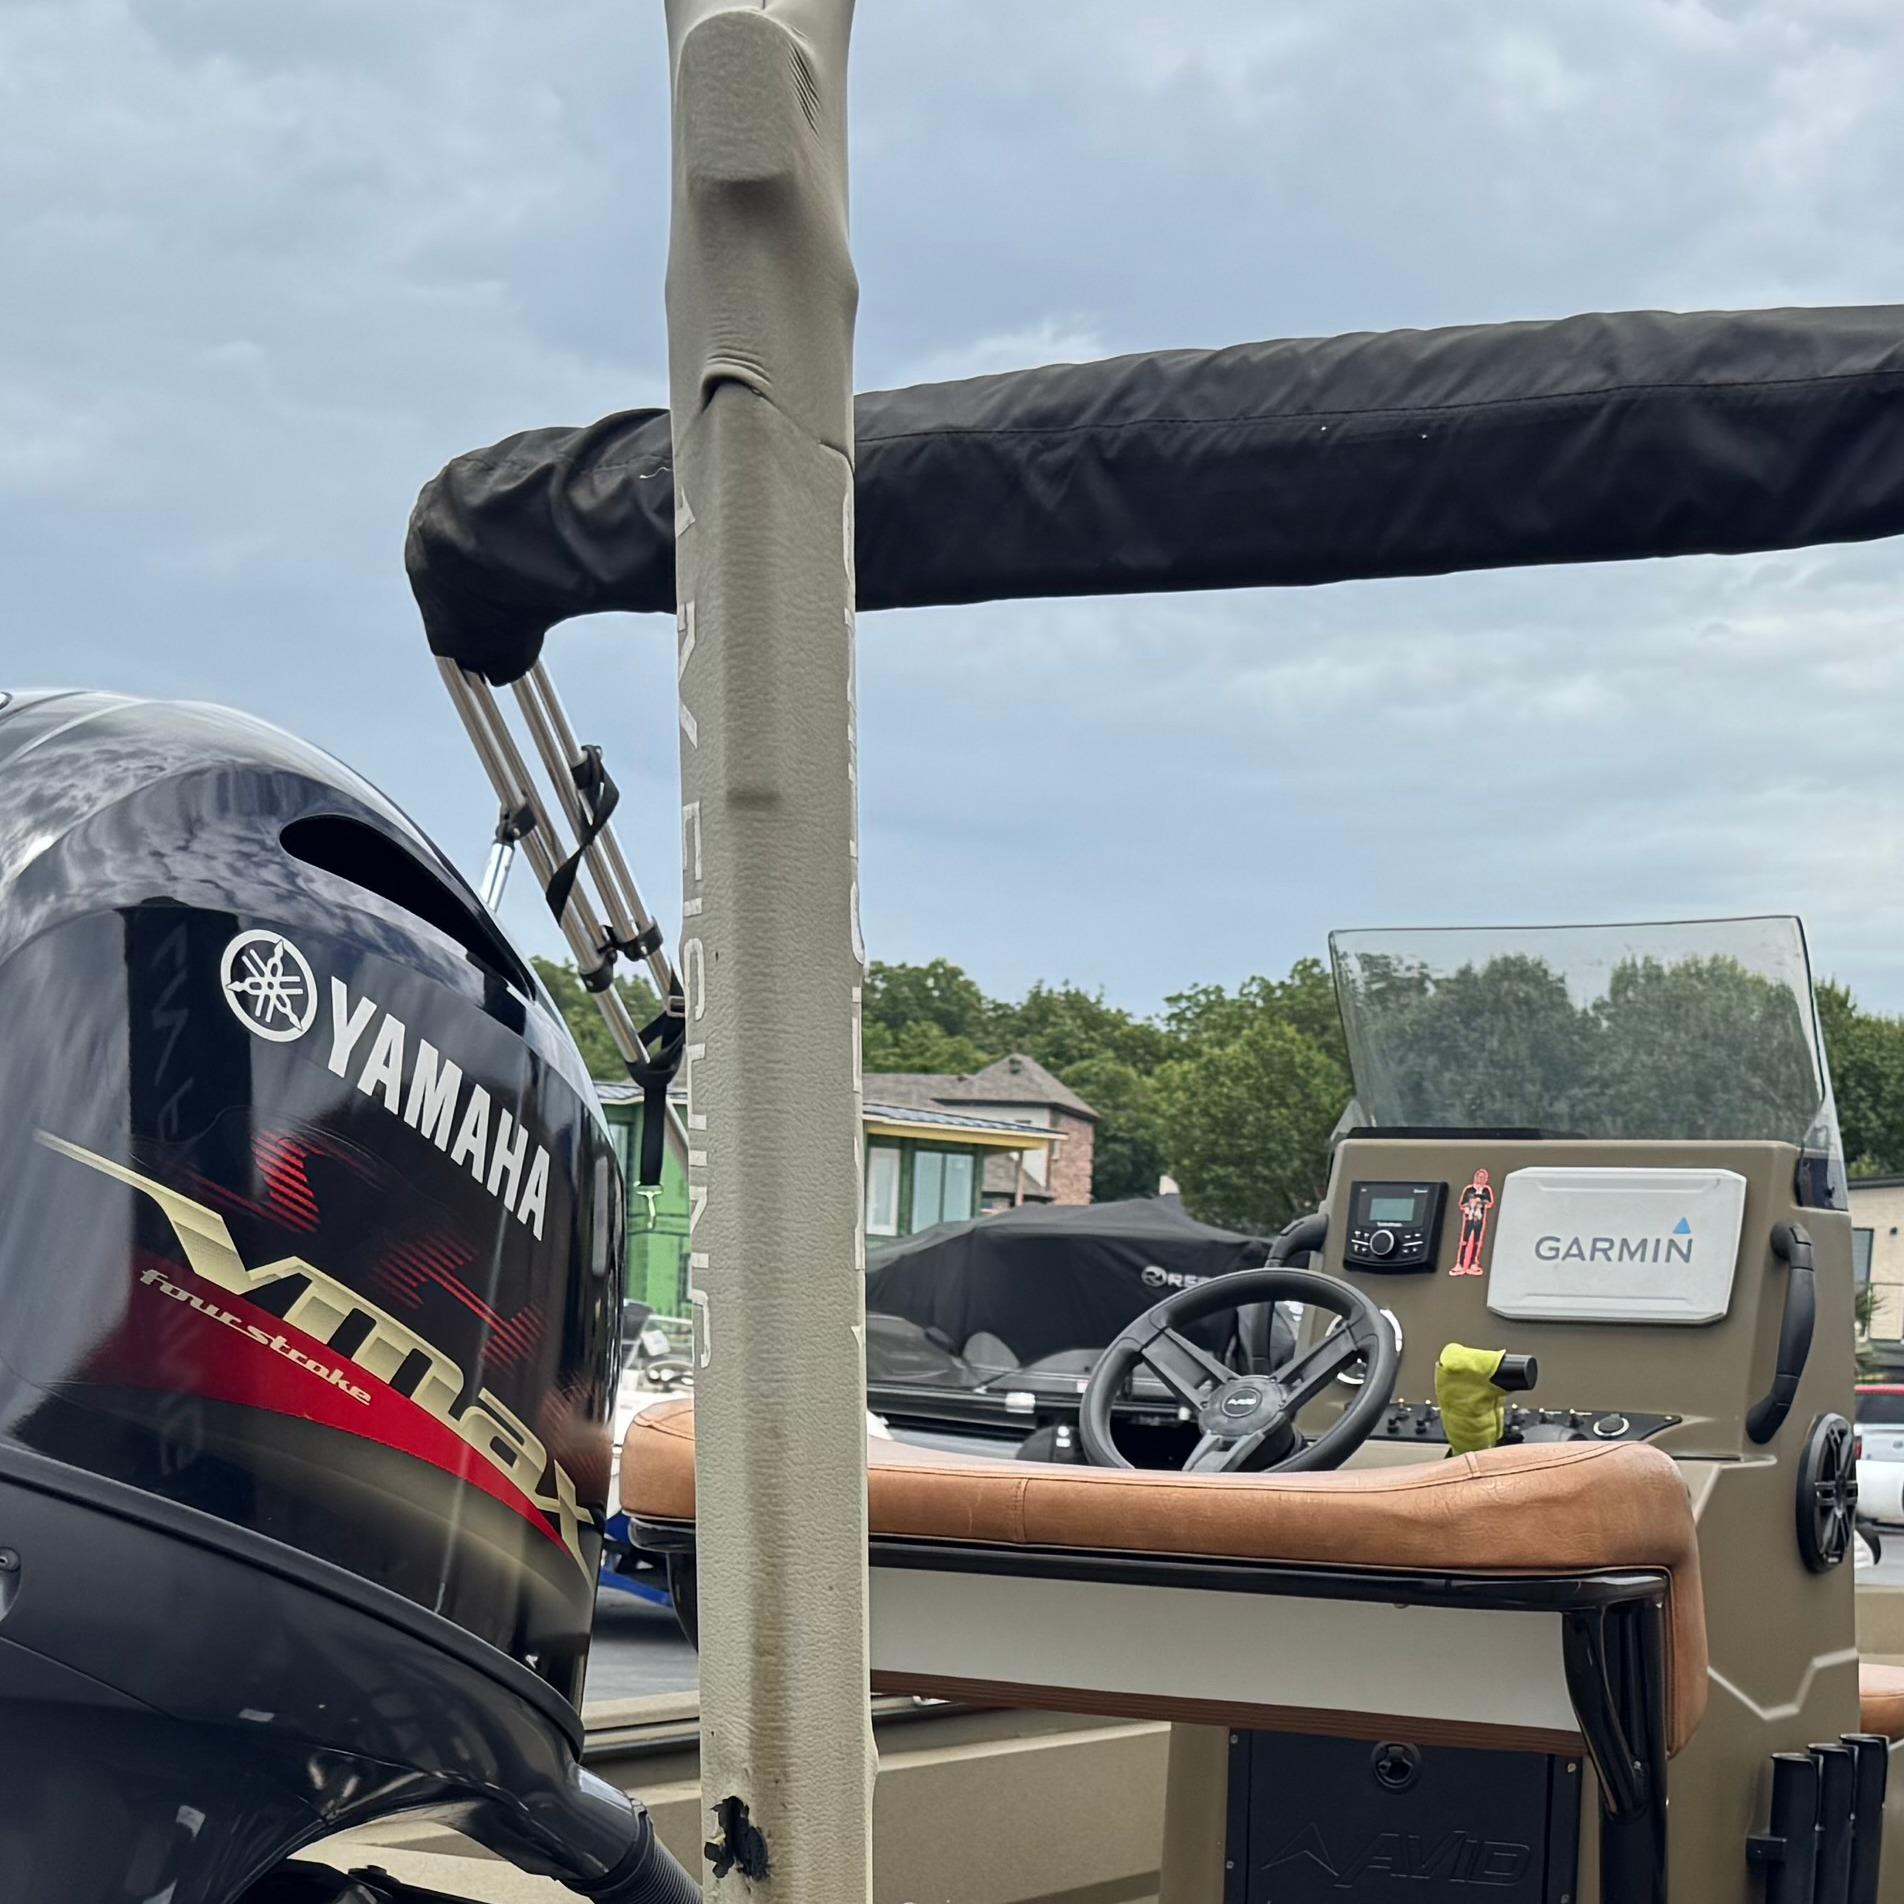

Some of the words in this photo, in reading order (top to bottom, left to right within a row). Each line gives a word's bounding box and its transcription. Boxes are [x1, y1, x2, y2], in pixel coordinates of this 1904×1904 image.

[327, 975, 550, 1242] YAMAHA
[1534, 1235, 1694, 1264] GARMIN
[1332, 1830, 1531, 1888] AVID
